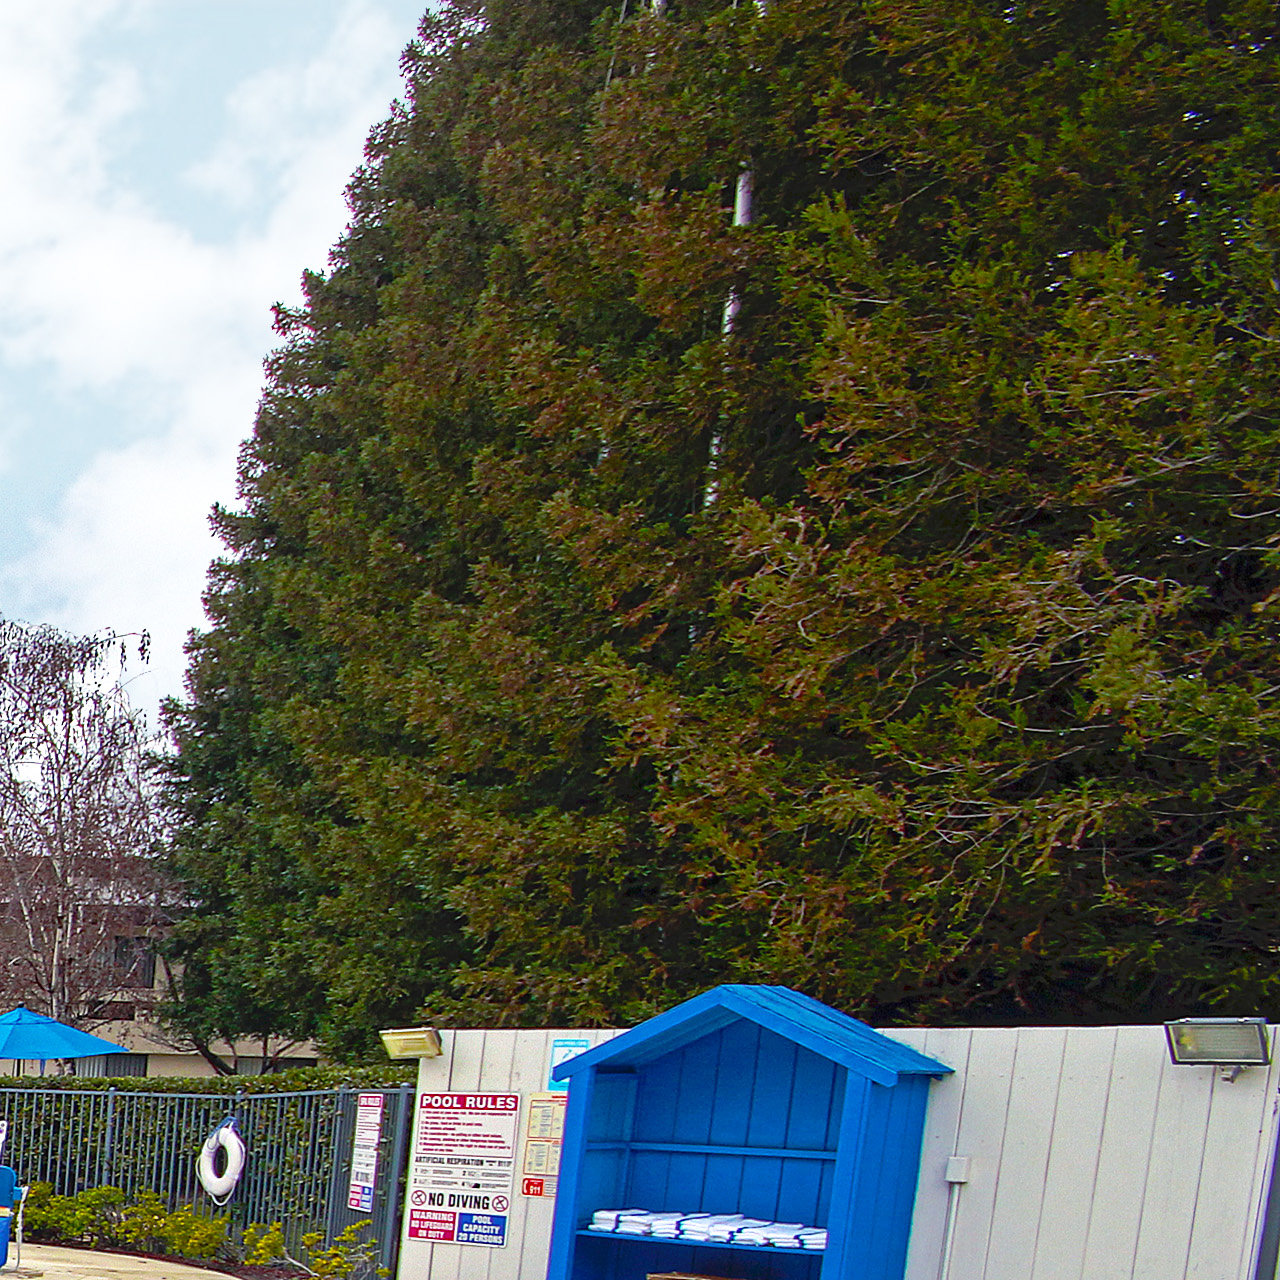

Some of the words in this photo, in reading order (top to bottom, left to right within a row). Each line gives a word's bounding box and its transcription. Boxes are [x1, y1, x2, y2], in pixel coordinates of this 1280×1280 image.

[422, 1096, 462, 1108] POOL
[466, 1096, 516, 1109] RULES
[414, 1156, 445, 1165] ARTIFICIAL
[447, 1158, 484, 1166] RESPIRATION
[428, 1192, 445, 1206] NO
[448, 1194, 490, 1210] DIVING
[412, 1211, 454, 1222] WARNING
[472, 1215, 492, 1225] POOL
[420, 1221, 454, 1231] LIFEGUARD
[463, 1224, 500, 1234] CAPACITY
[428, 1230, 445, 1238] DUTY
[469, 1234, 503, 1244] PERSONS
